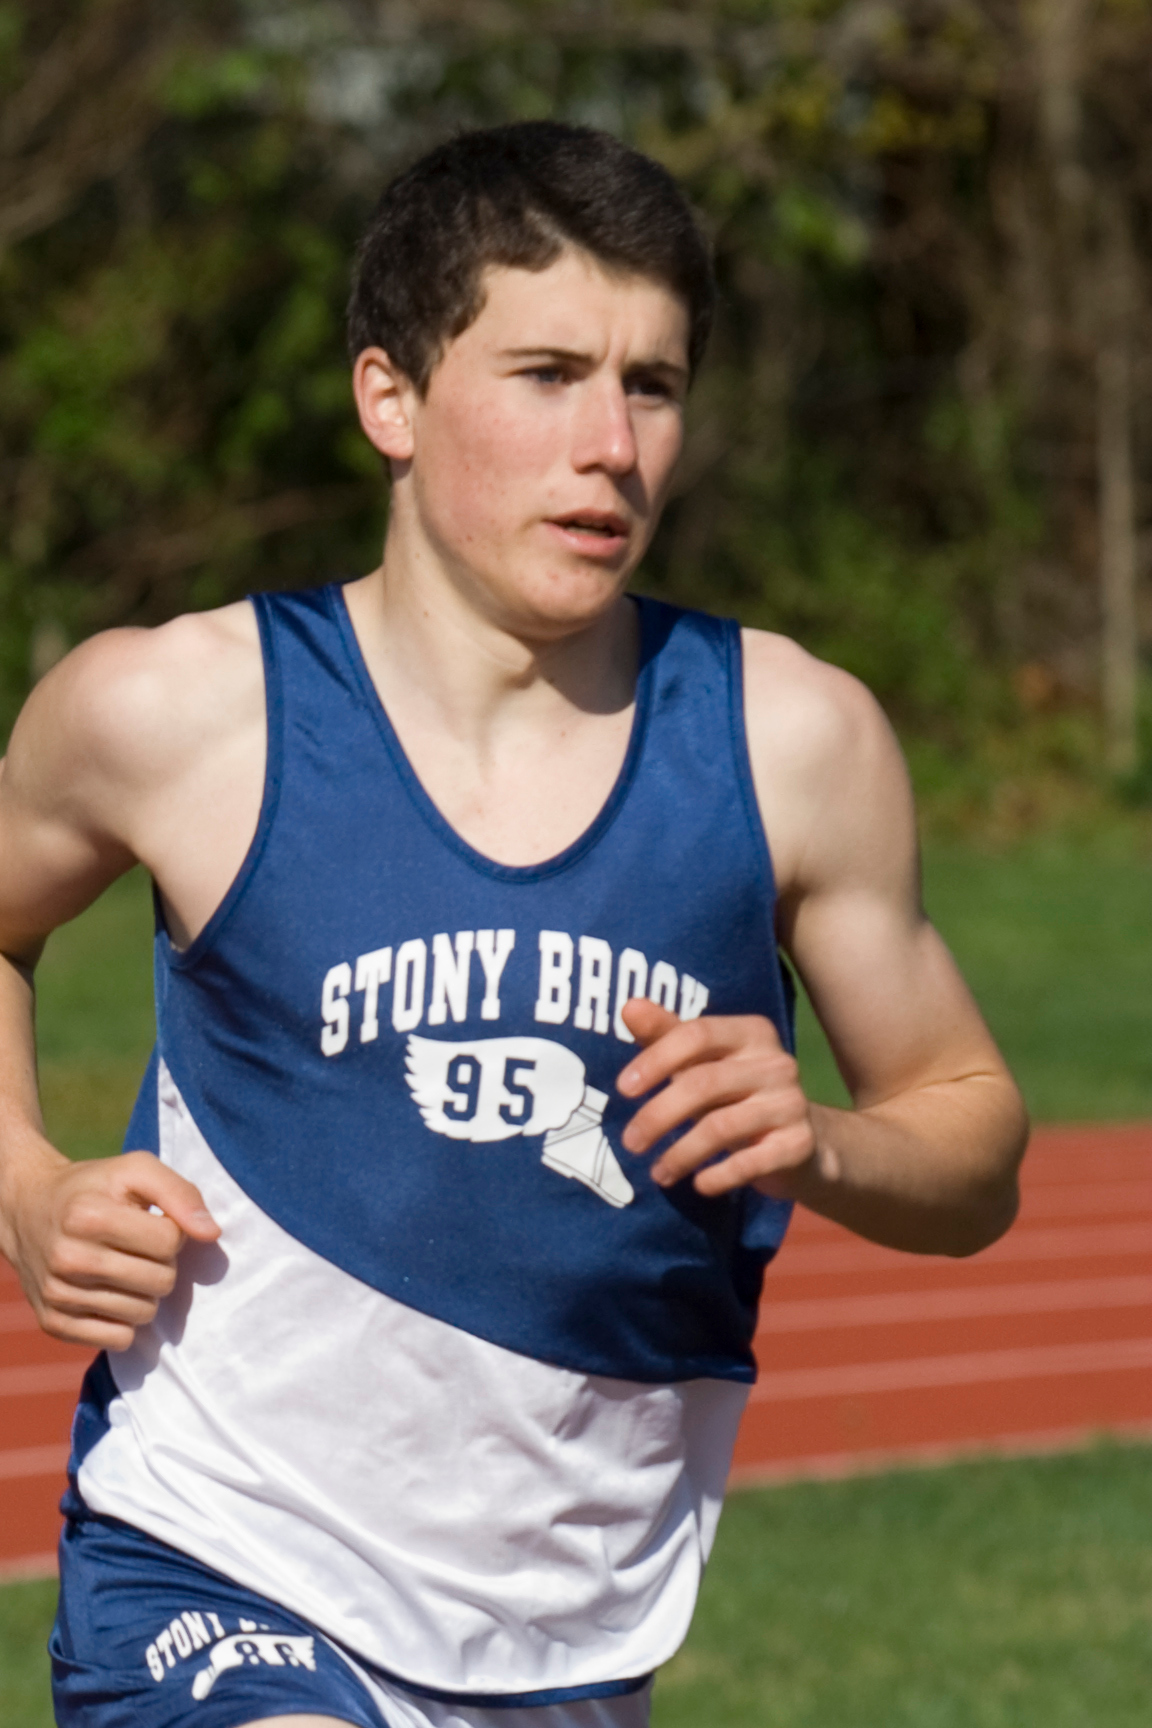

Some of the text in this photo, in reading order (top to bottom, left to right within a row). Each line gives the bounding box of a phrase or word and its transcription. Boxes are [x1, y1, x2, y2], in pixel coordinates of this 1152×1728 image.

[320, 928, 516, 1058] STONY
[442, 1053, 538, 1126] 95
[145, 1610, 226, 1683] STONY
